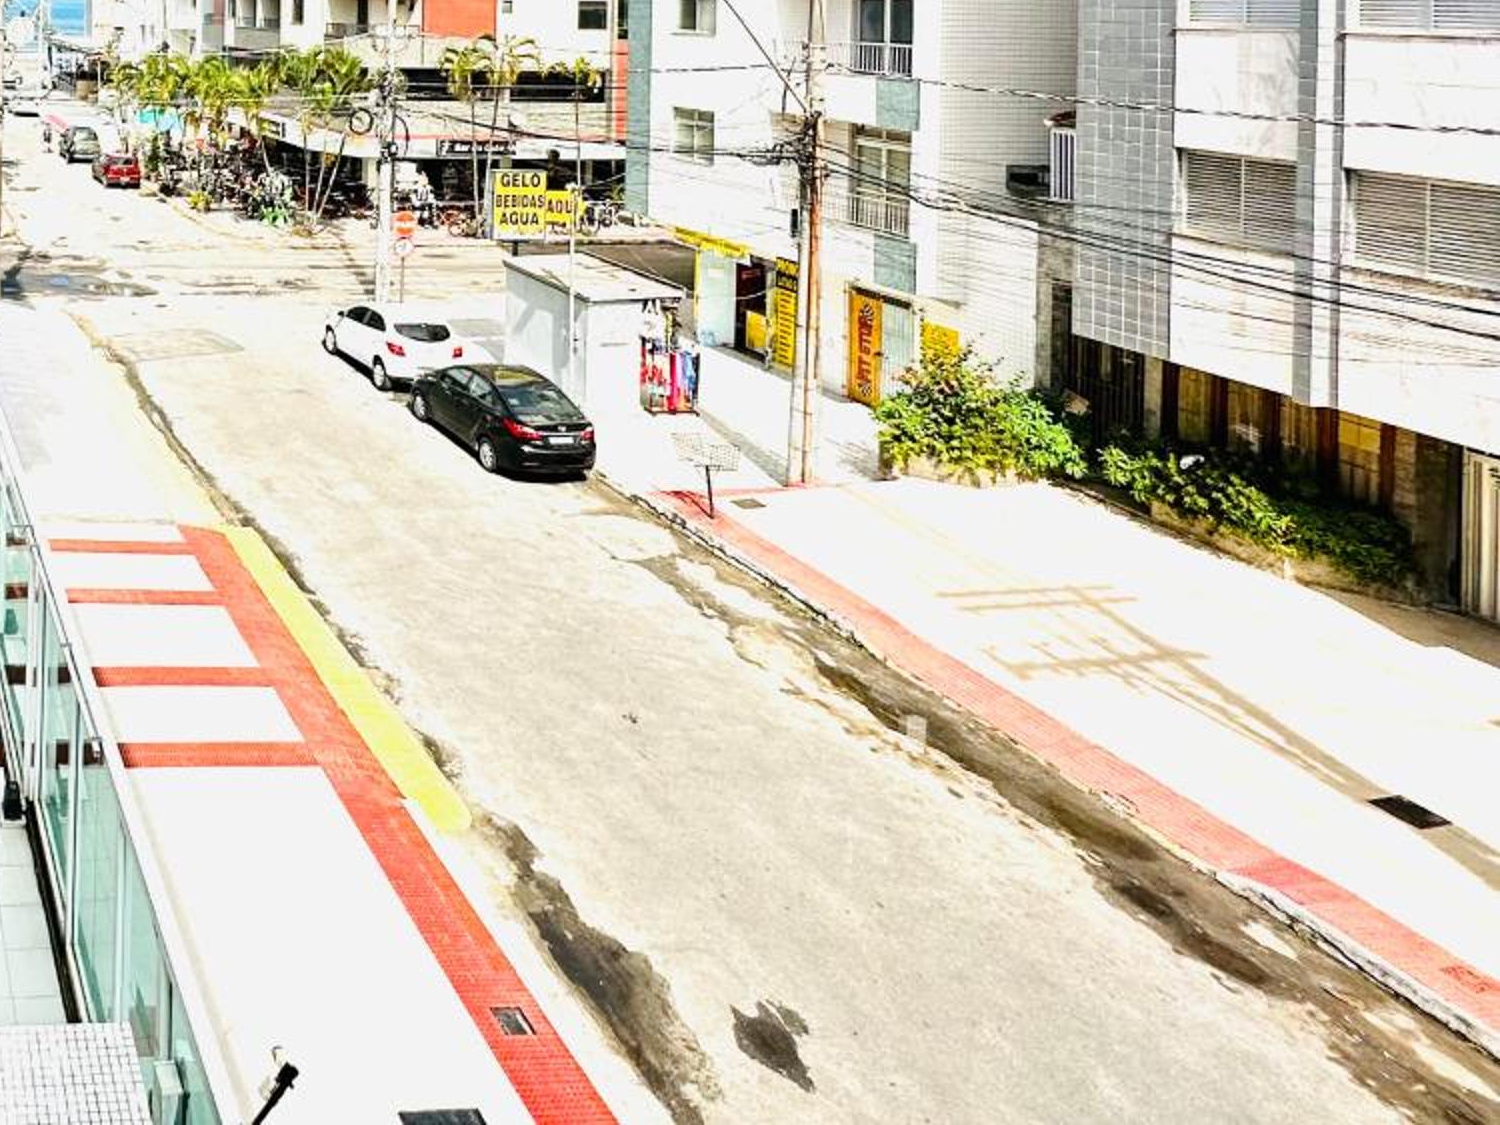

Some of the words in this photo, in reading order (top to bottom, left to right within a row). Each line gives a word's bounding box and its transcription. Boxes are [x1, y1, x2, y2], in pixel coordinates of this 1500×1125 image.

[501, 173, 541, 188] GELO
[495, 194, 545, 208] BEBIDAS
[547, 198, 576, 214] AQU
[499, 211, 539, 225] AGUA
